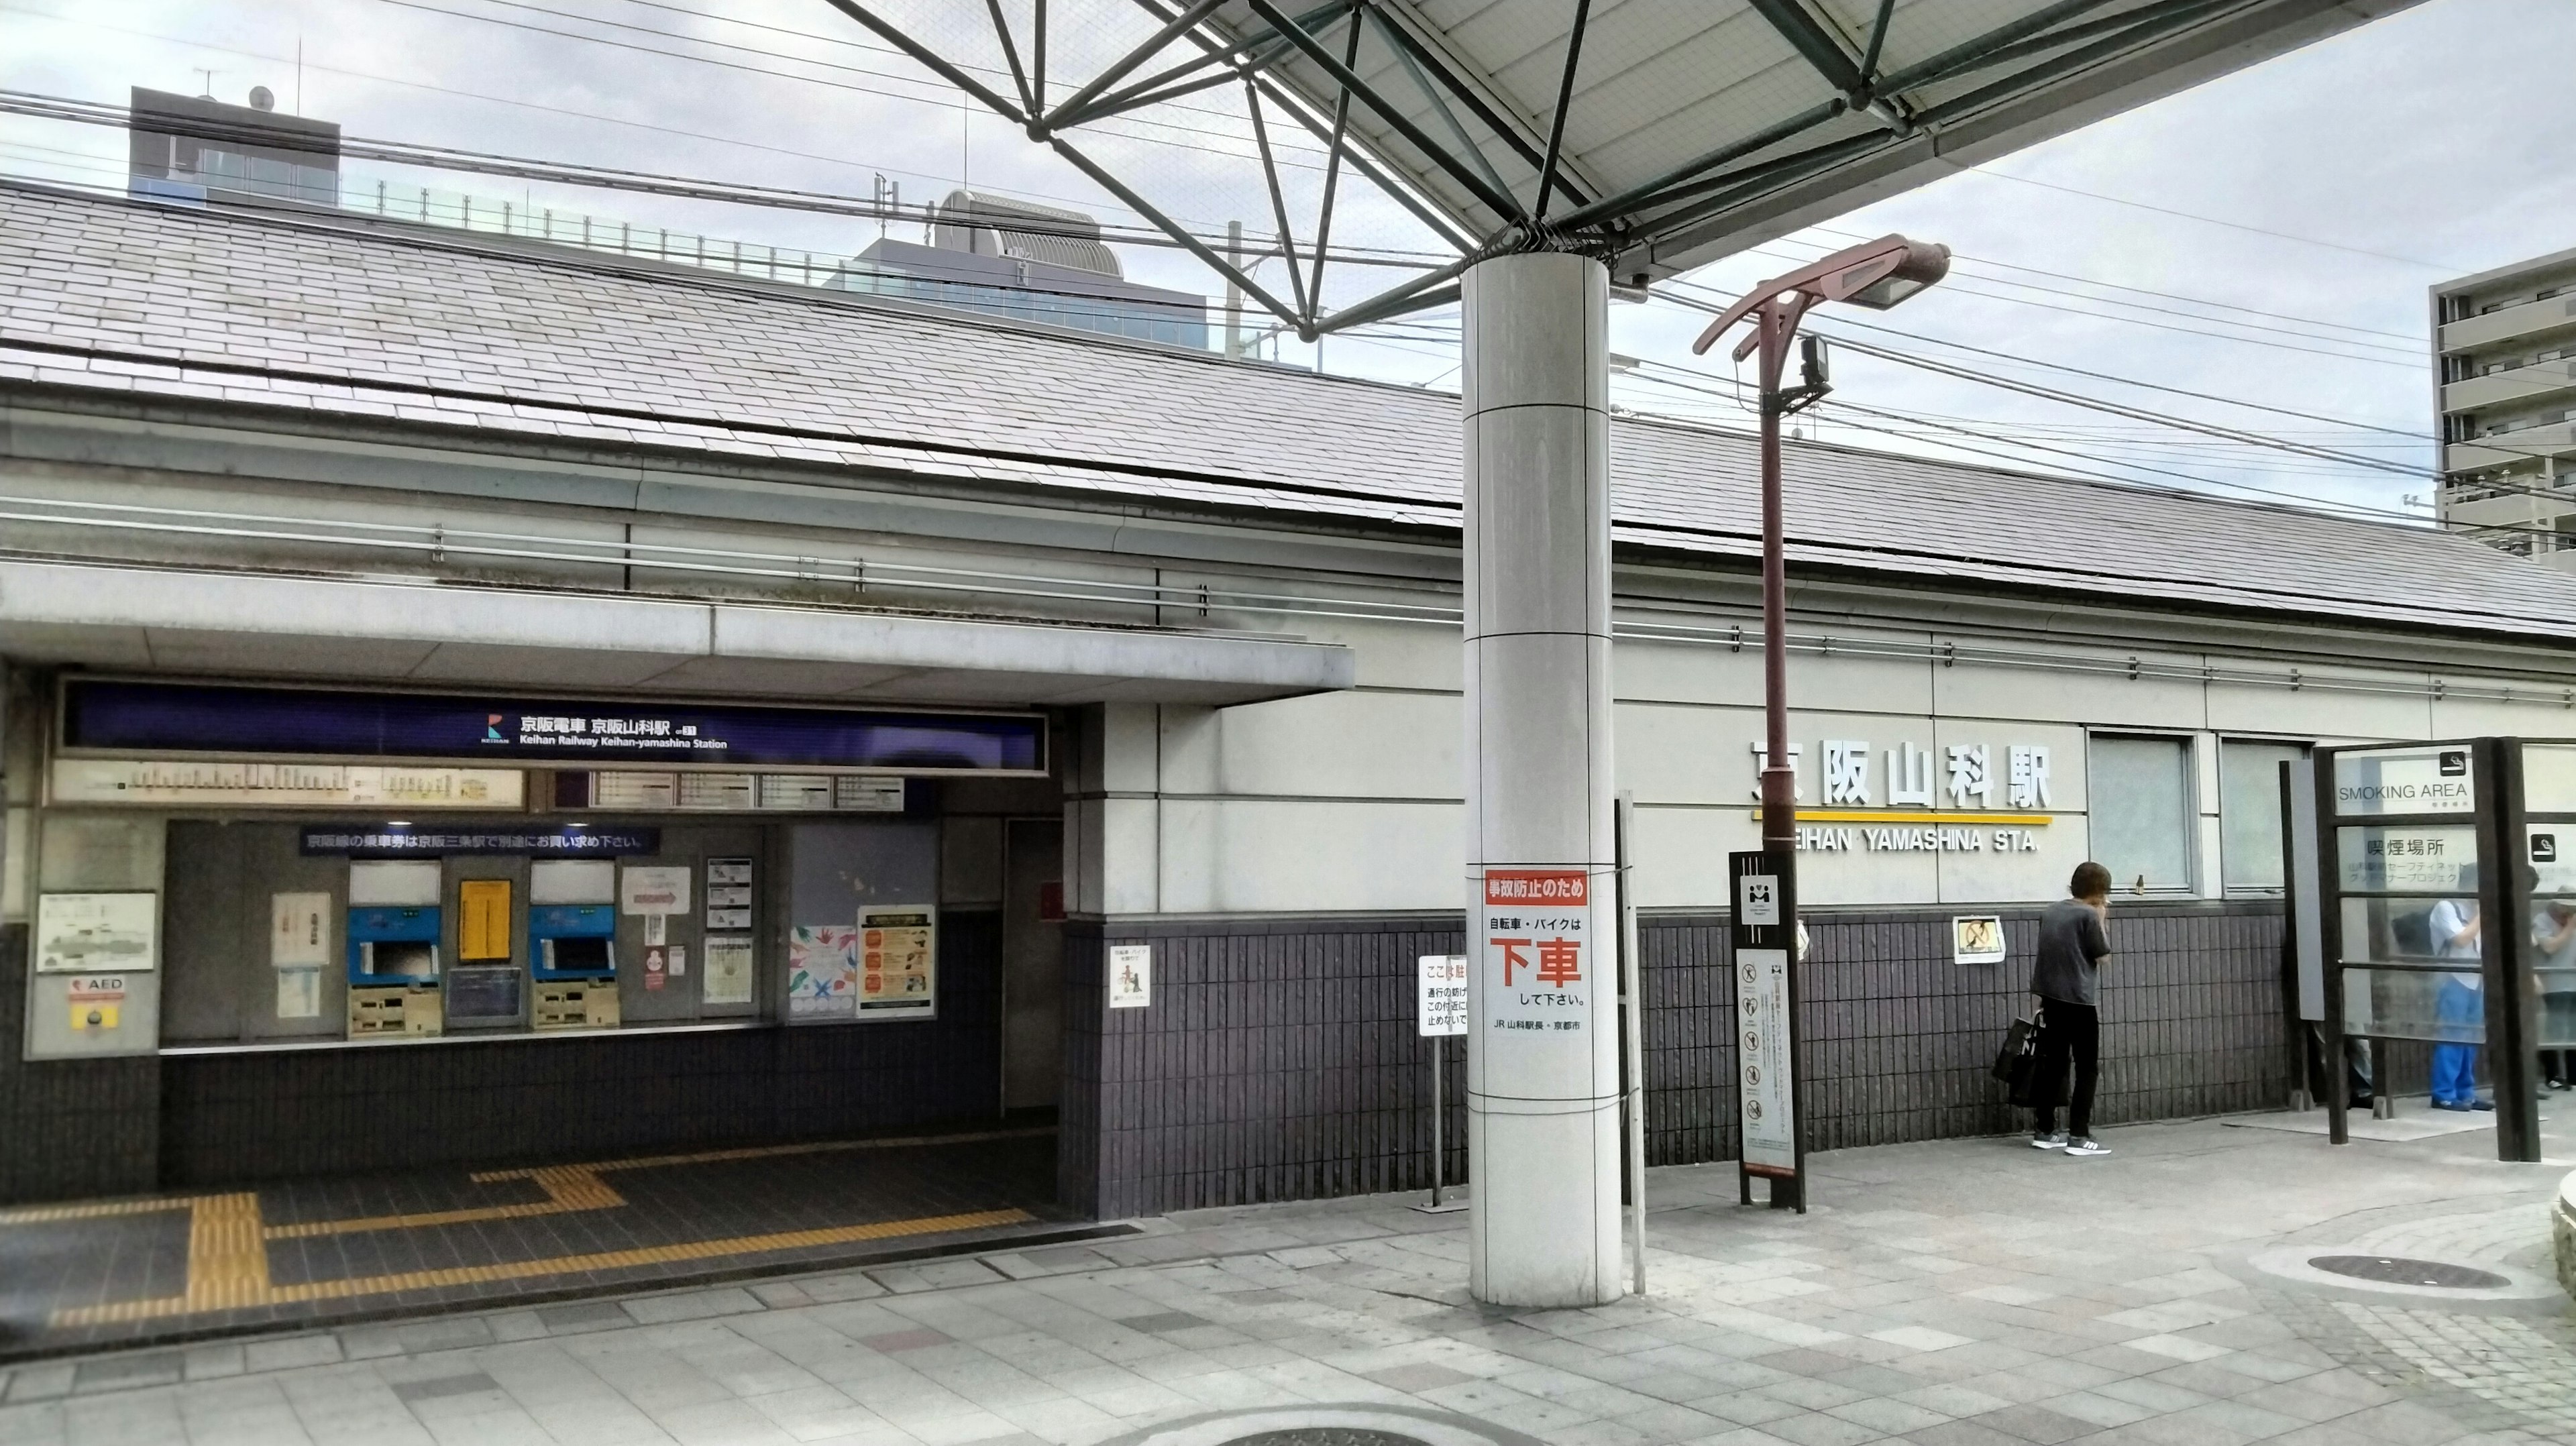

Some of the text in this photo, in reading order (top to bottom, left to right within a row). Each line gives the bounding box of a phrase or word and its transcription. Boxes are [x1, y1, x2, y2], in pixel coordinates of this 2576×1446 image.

[521, 716, 670, 736] 京阪電車 京阪山科駅
[520, 735, 727, 748] Keihan Railway Keihan-yamashina Station
[2339, 783, 2467, 801] SMOKING AREA
[1795, 828, 2040, 850] EIHAN YAMASHINA STA.
[2367, 839, 2445, 856] 喫煙場所
[1489, 878, 1584, 897] 事故防止のため
[1490, 917, 1581, 930] 自転車・バイクは
[1490, 936, 1582, 988] 下車
[1428, 964, 1467, 978] ここは駐
[89, 979, 122, 989] AED
[1428, 1001, 1467, 1011] この付近に
[1520, 993, 1584, 1006] して下さい。
[1428, 1015, 1467, 1025] 止めないで
[1494, 1020, 1580, 1030] JR 山科駅長・京都市
